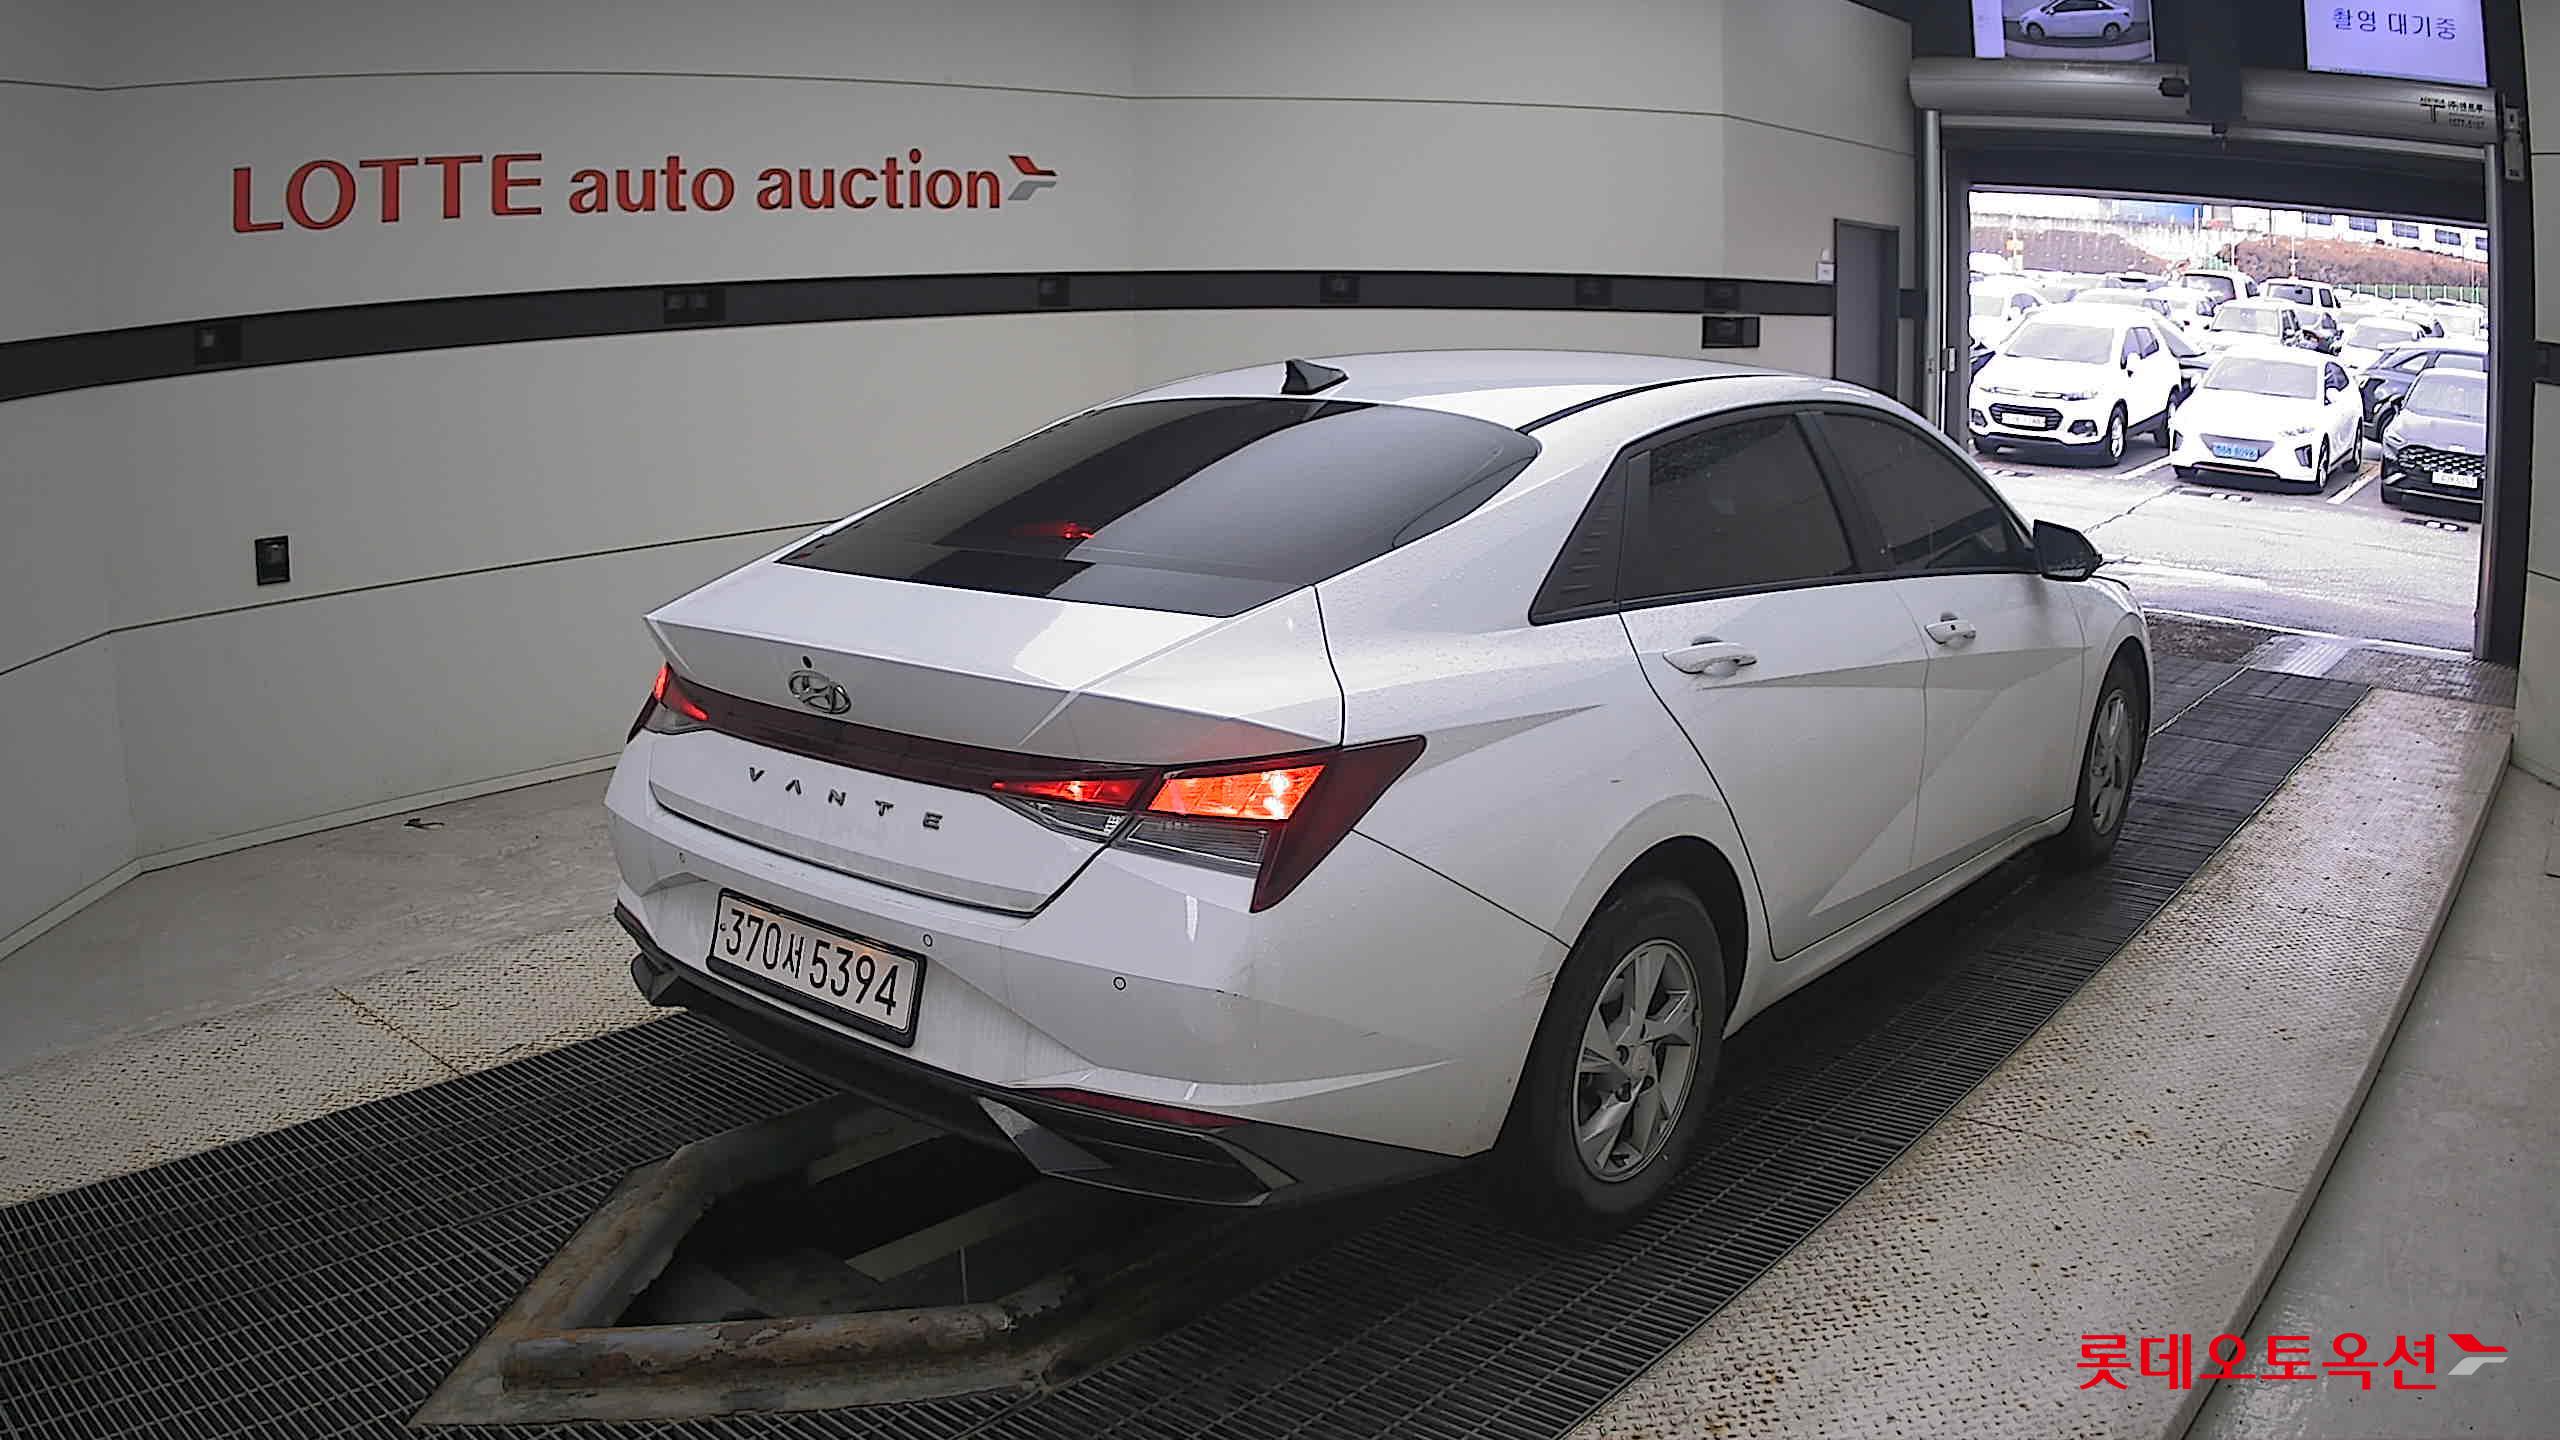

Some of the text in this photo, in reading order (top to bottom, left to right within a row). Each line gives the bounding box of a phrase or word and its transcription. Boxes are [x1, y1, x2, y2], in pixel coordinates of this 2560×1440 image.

[2333, 7, 2457, 40] 촬영 대기중
[233, 147, 1003, 234] LOTTE auto auction
[749, 767, 943, 830] VANTE
